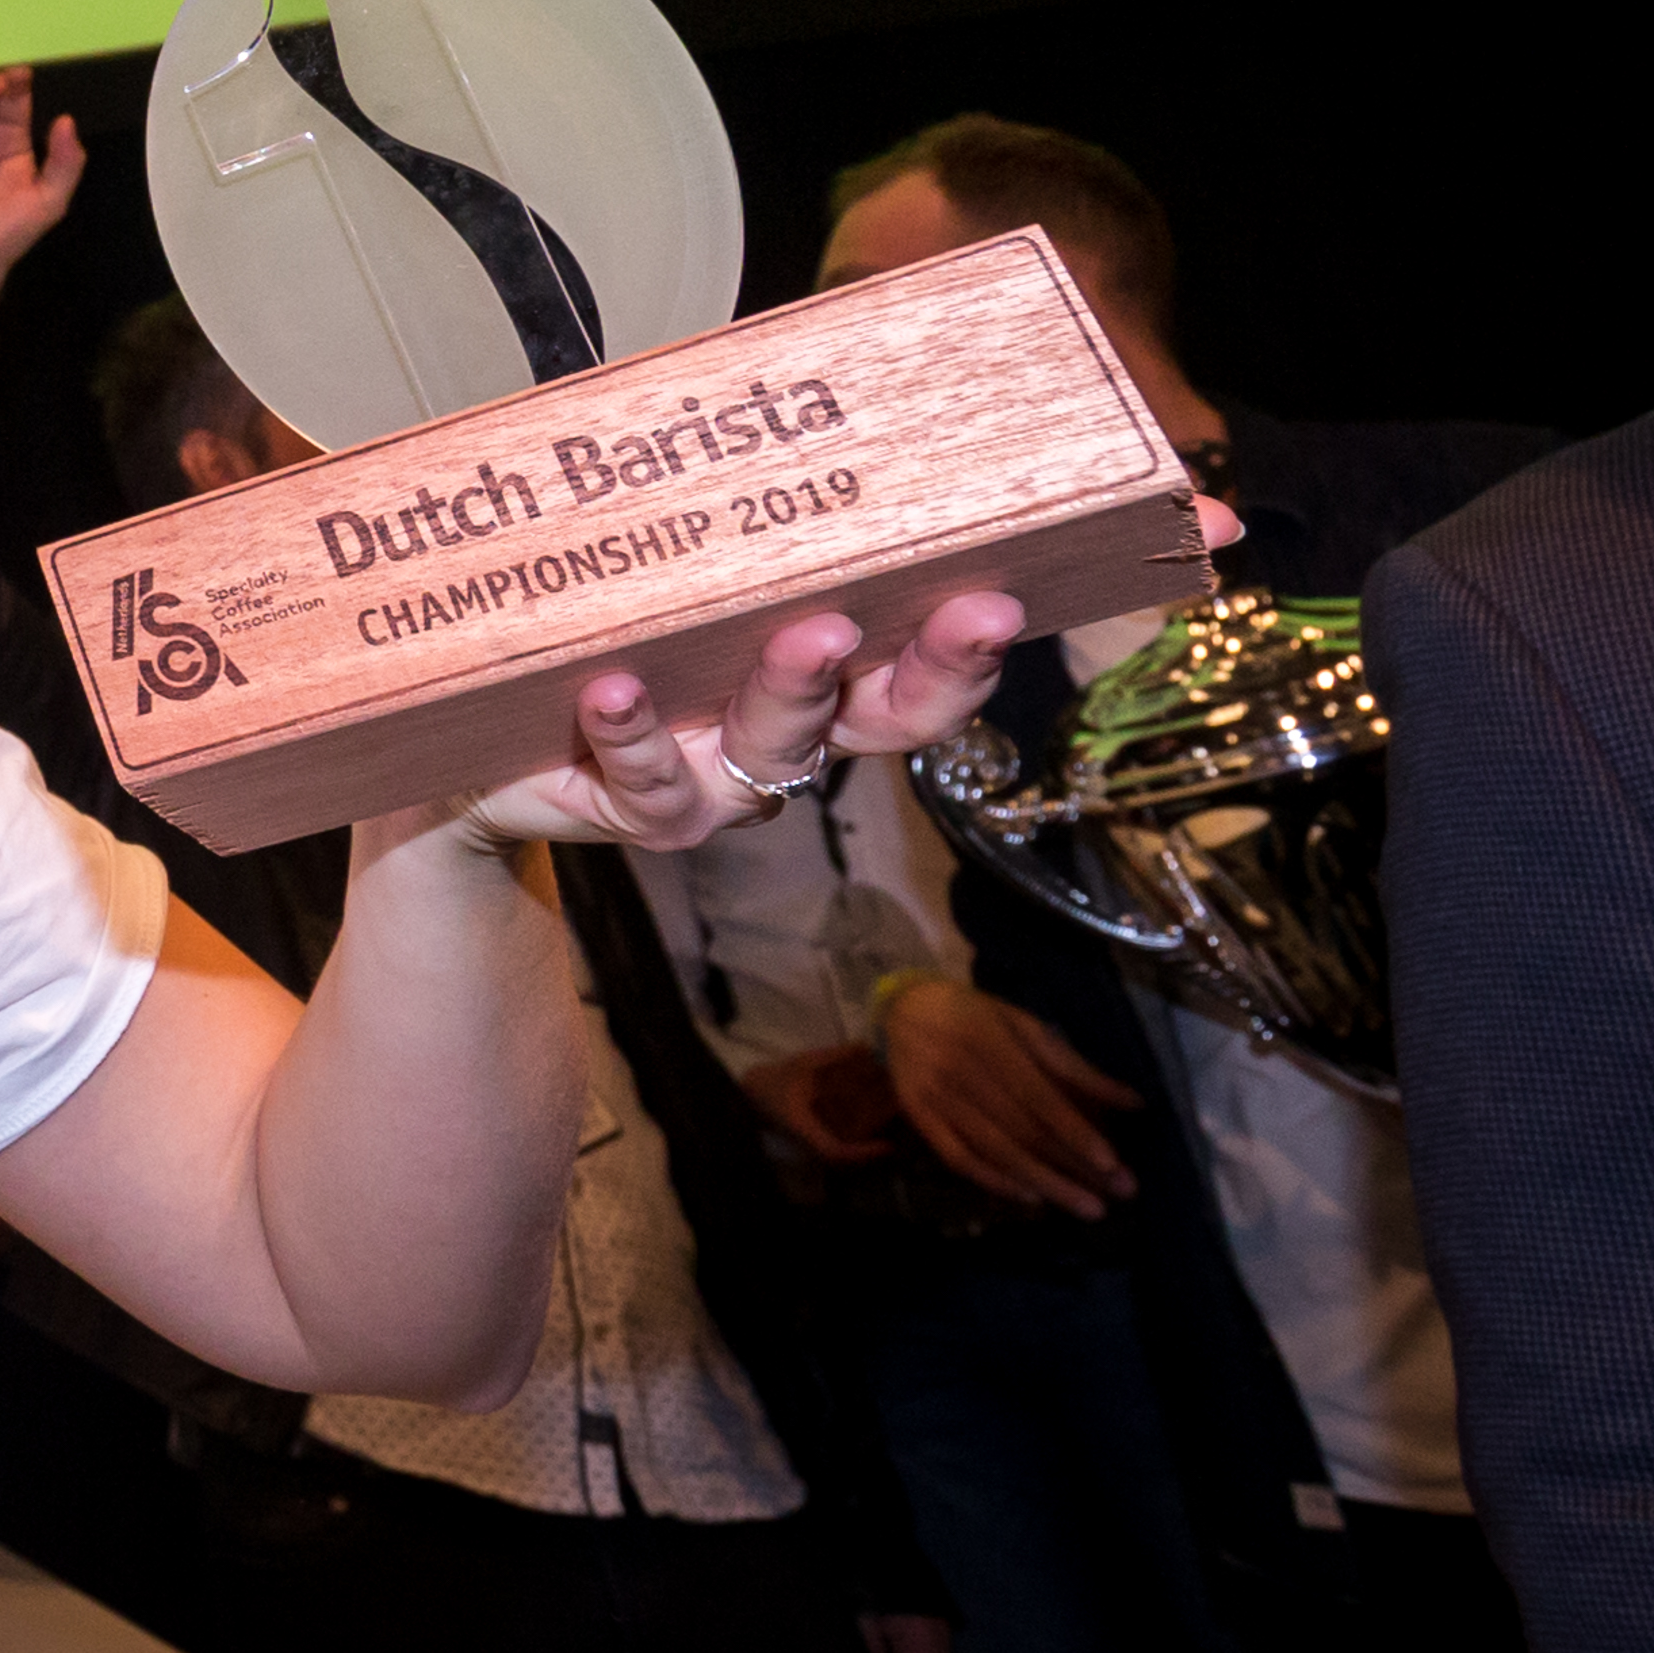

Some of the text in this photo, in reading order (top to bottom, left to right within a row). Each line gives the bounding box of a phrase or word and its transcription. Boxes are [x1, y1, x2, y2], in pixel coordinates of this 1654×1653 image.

[316, 377, 849, 578] Dutch Barista
[356, 466, 862, 647] CHAMPIONSHIP 2019
[204, 569, 289, 604] Specialty
[211, 594, 274, 621] Coffee
[219, 596, 327, 638] Association
